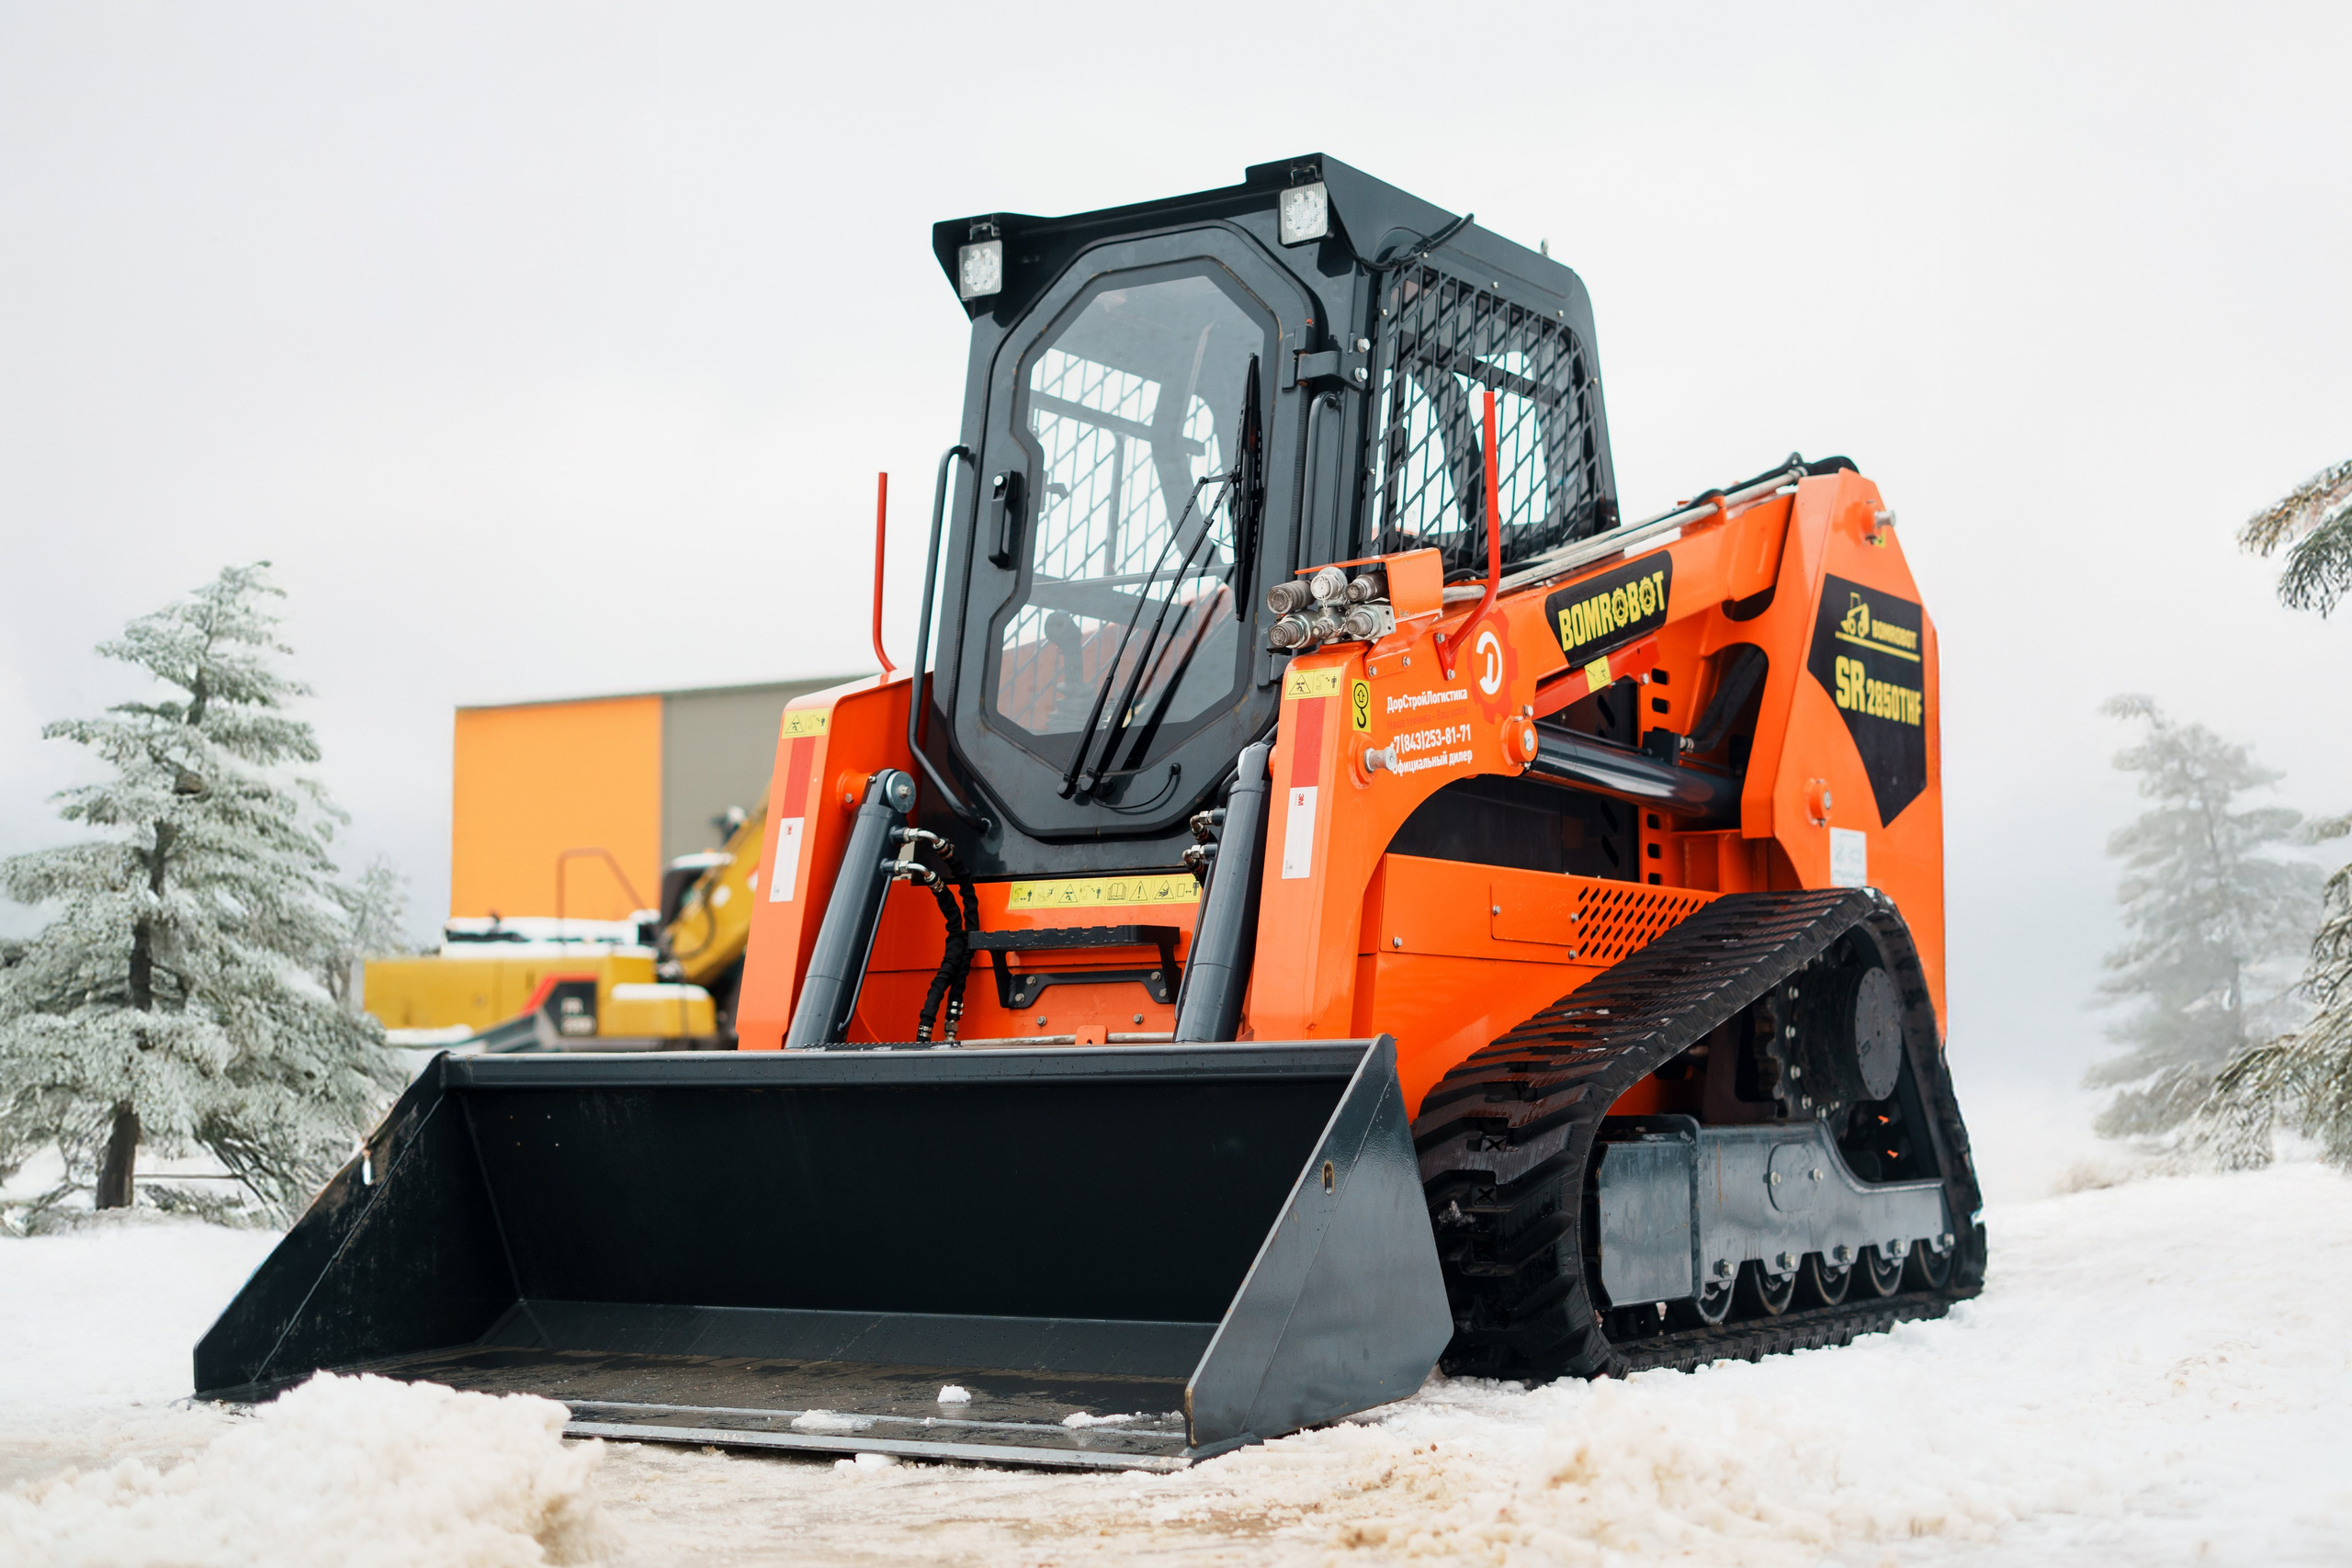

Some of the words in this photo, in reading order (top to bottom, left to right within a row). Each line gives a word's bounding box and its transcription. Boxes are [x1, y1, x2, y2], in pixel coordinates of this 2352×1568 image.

[1558, 570, 1666, 652] BOMROBOT
[1386, 689, 1467, 714] ДорСтройЛогистика
[1387, 718, 1406, 730] Наша
[1407, 714, 1431, 726] техника
[1436, 708, 1451, 720] Ваш
[1449, 750, 1473, 766] дилер
